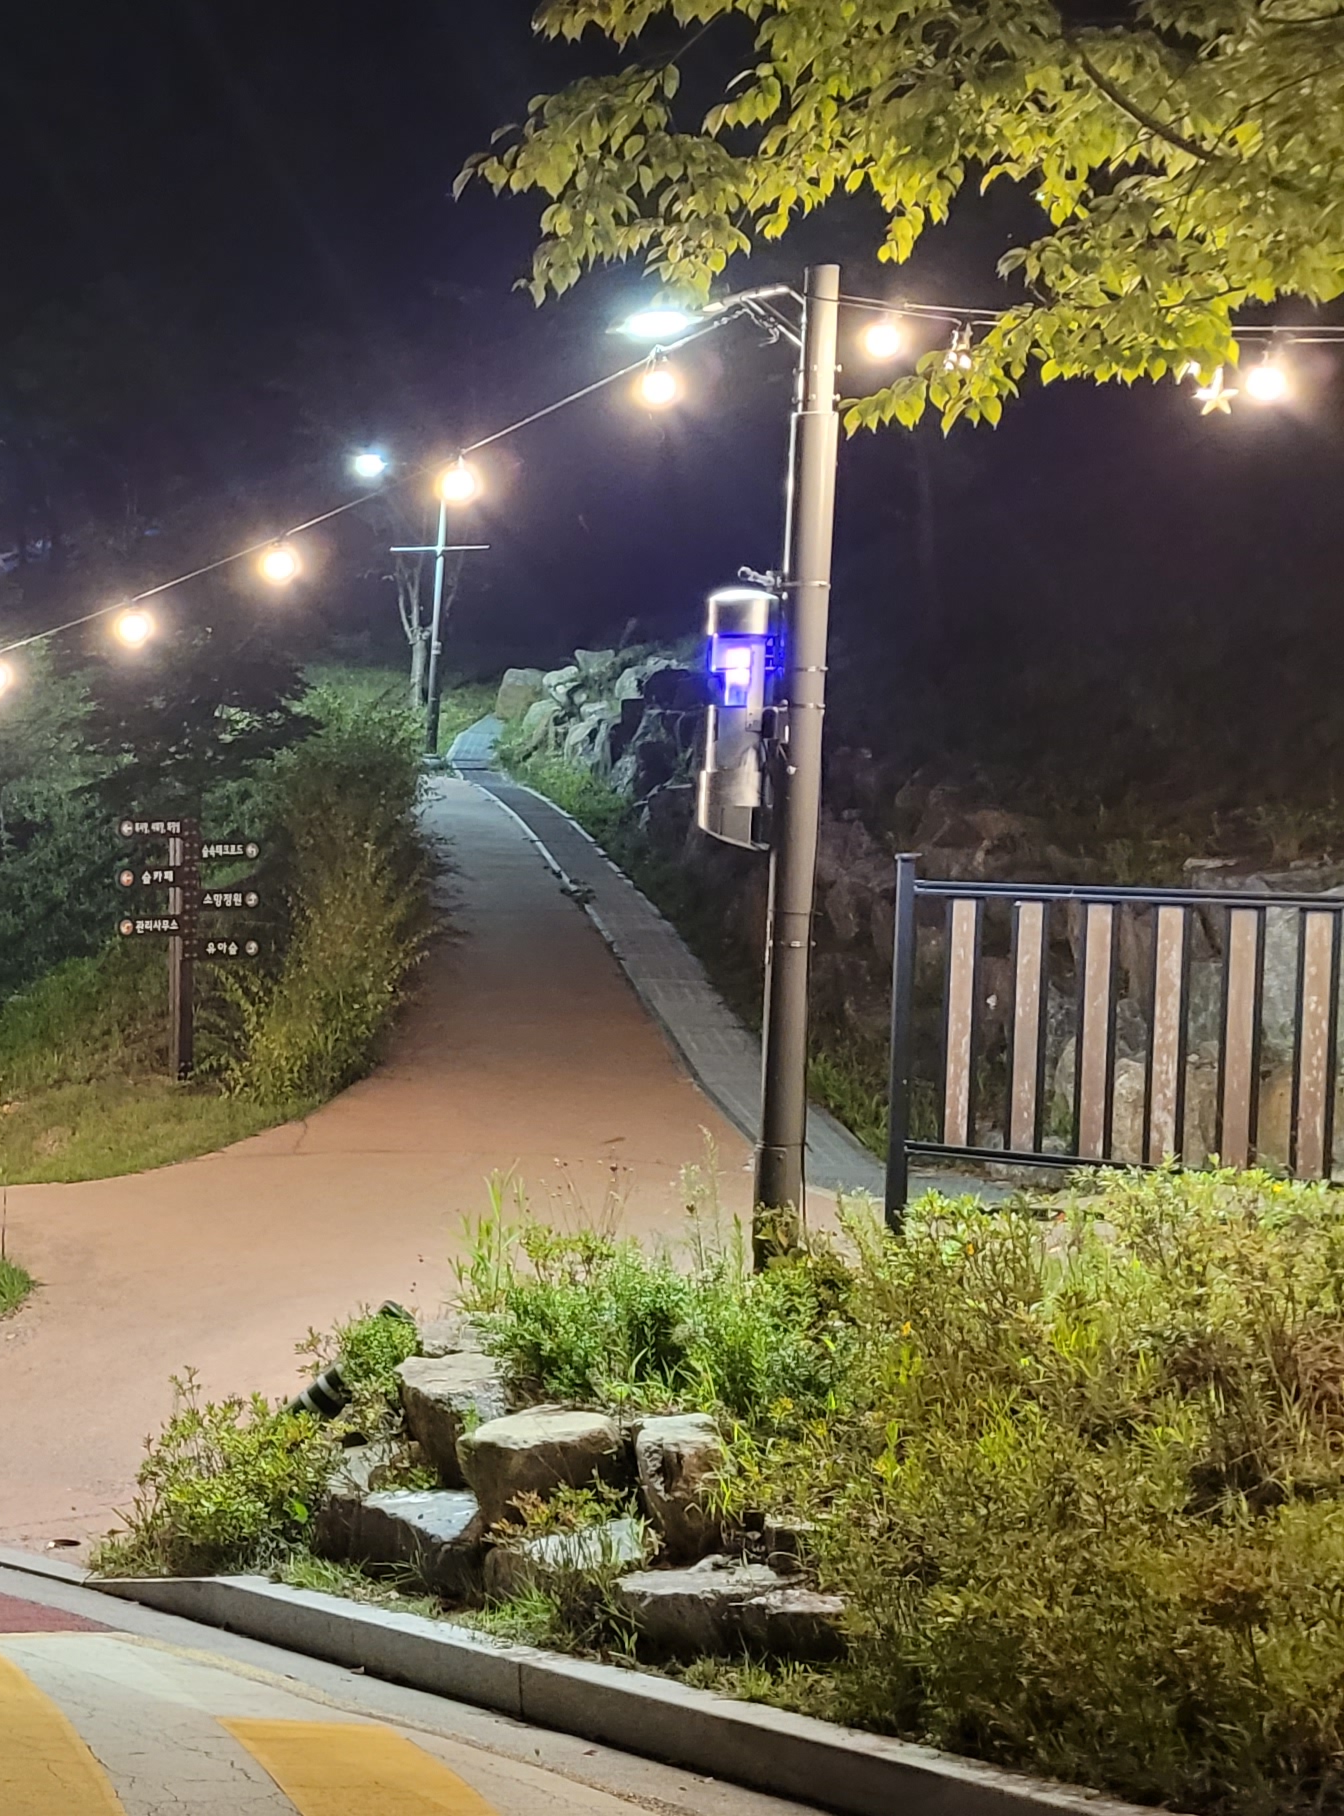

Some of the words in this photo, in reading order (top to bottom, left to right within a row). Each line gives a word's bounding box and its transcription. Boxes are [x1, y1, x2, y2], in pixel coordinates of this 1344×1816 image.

[202, 893, 243, 907] 소망정원
[135, 919, 179, 934] 관리사무소
[205, 941, 239, 956] 유아숲
